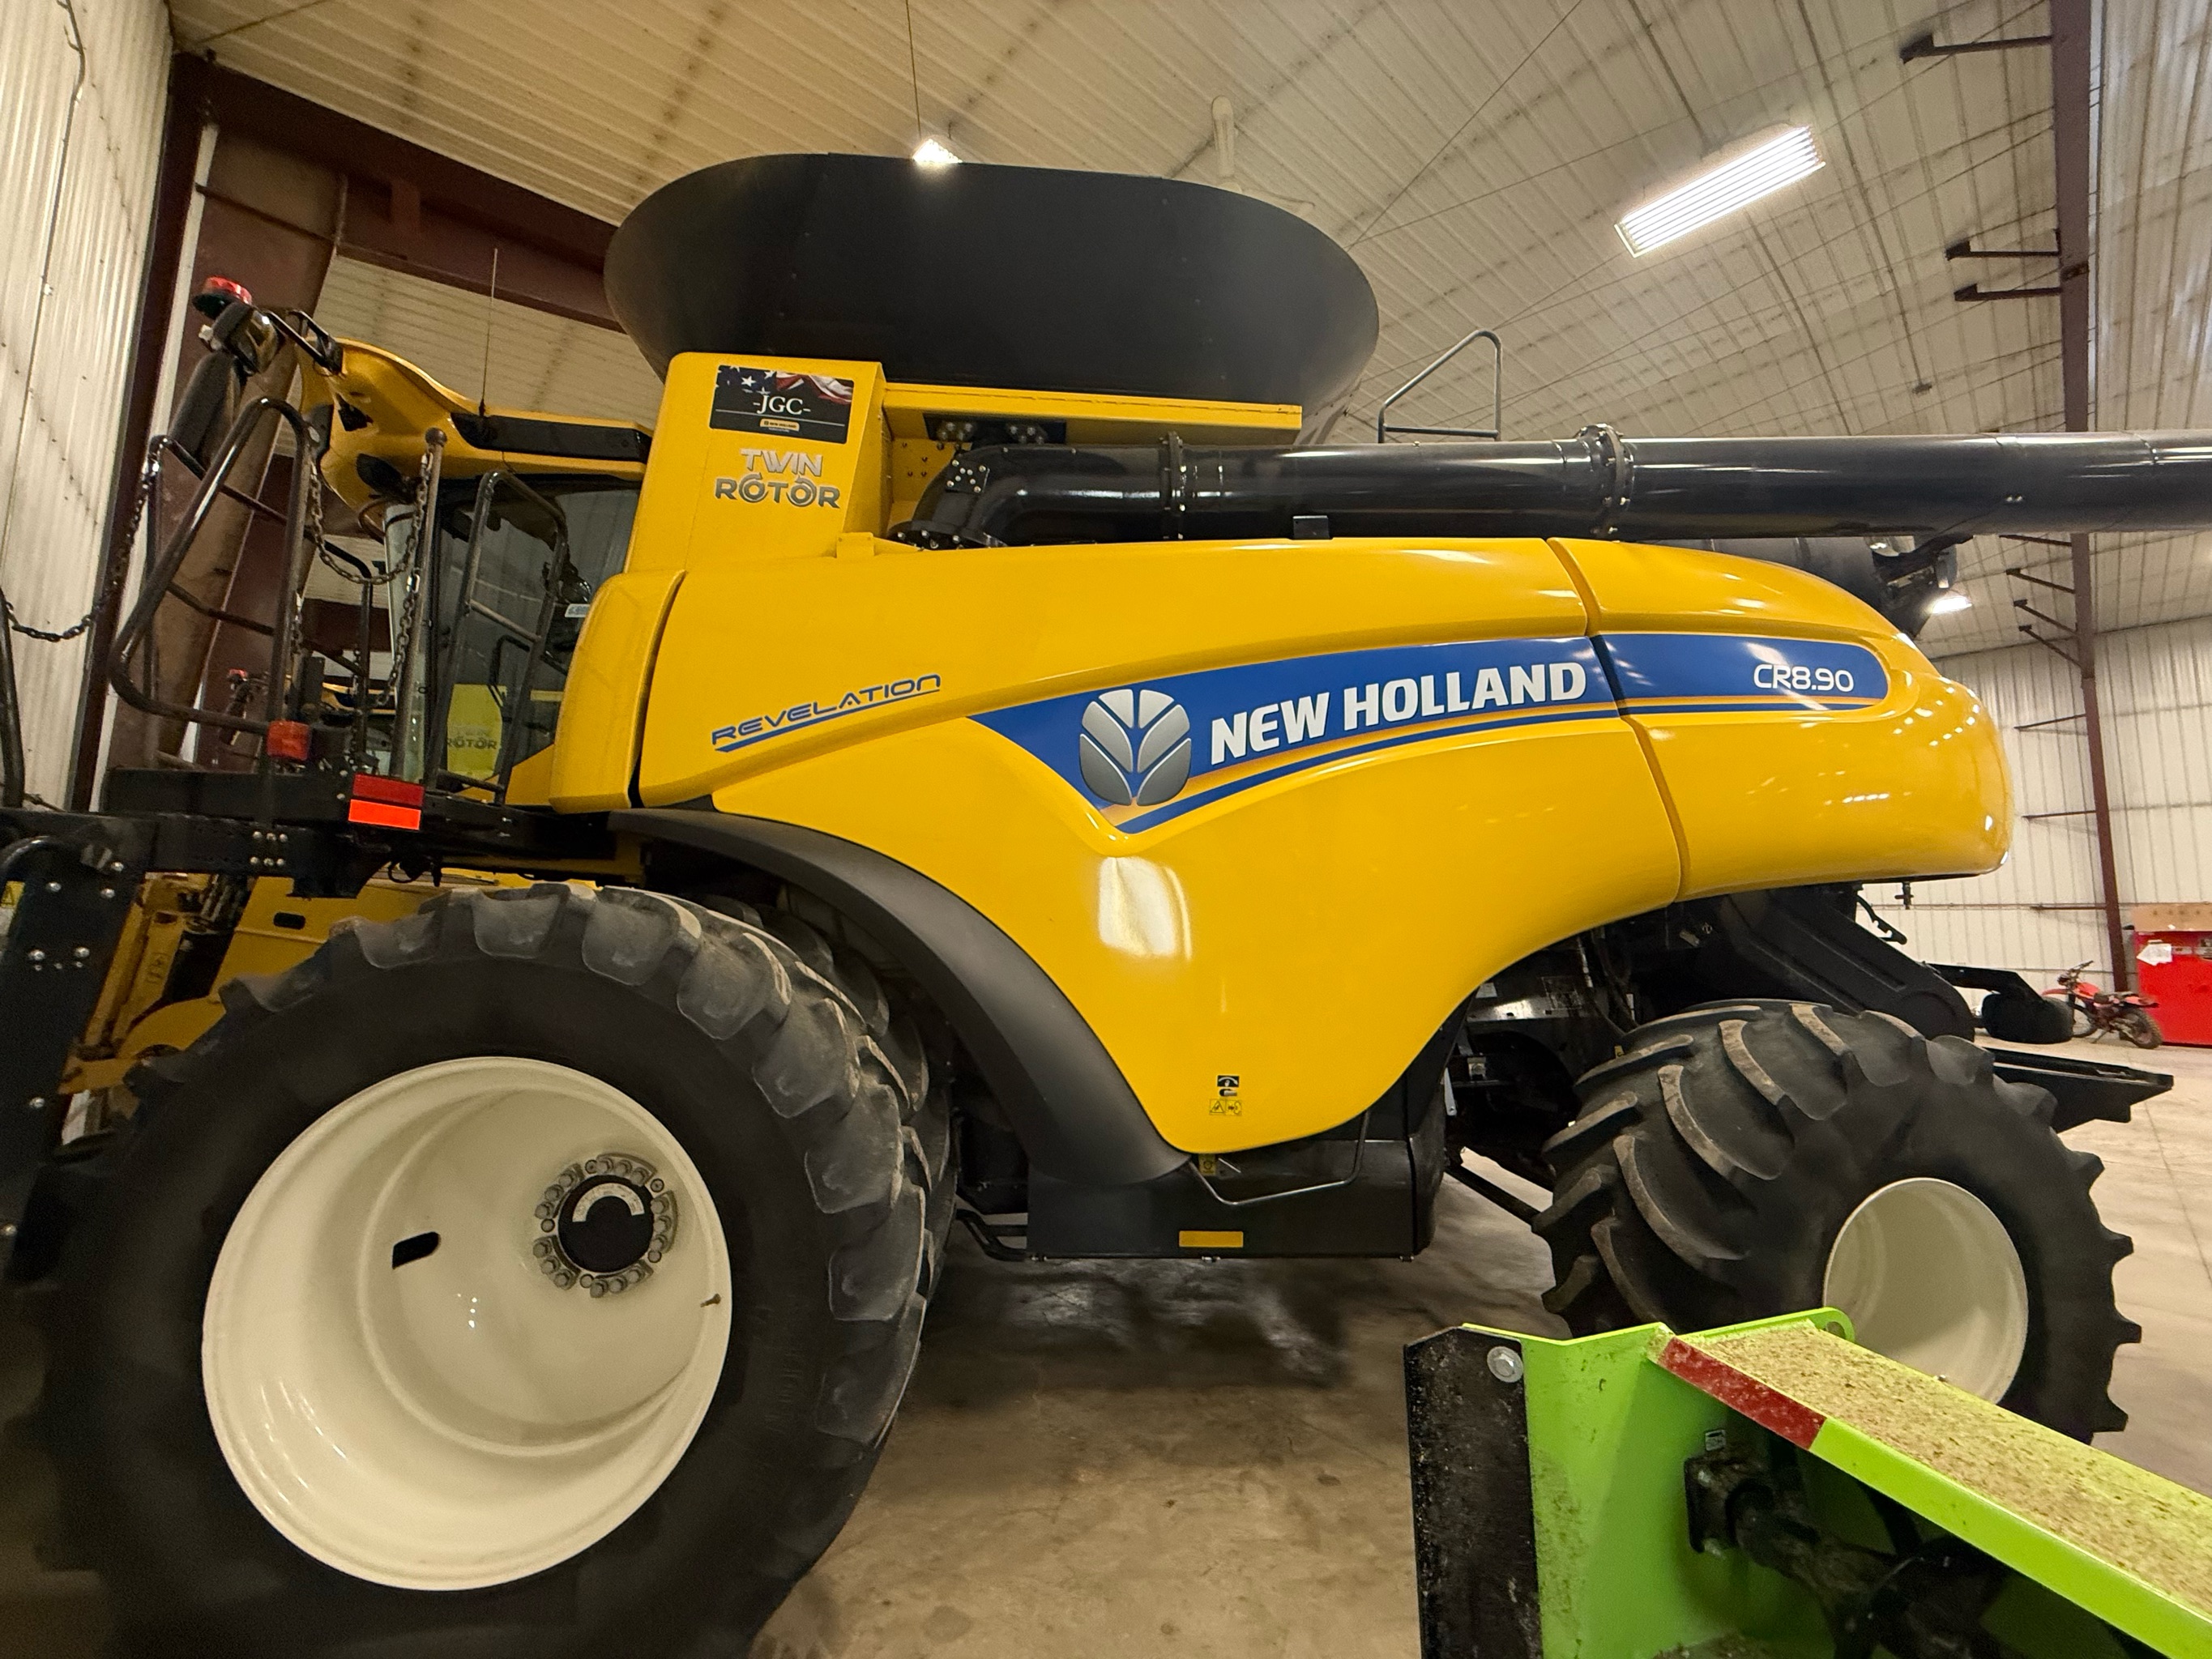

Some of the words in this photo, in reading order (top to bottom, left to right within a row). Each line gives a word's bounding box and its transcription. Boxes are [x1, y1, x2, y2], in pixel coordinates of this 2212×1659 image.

[739, 448, 823, 477] TWIN
[715, 471, 840, 509] ROTOR
[1753, 663, 1855, 693] CR8.90
[711, 673, 941, 744] REVELATION
[1211, 691, 1330, 766] NEW
[1343, 661, 1586, 731] HOLLAND
